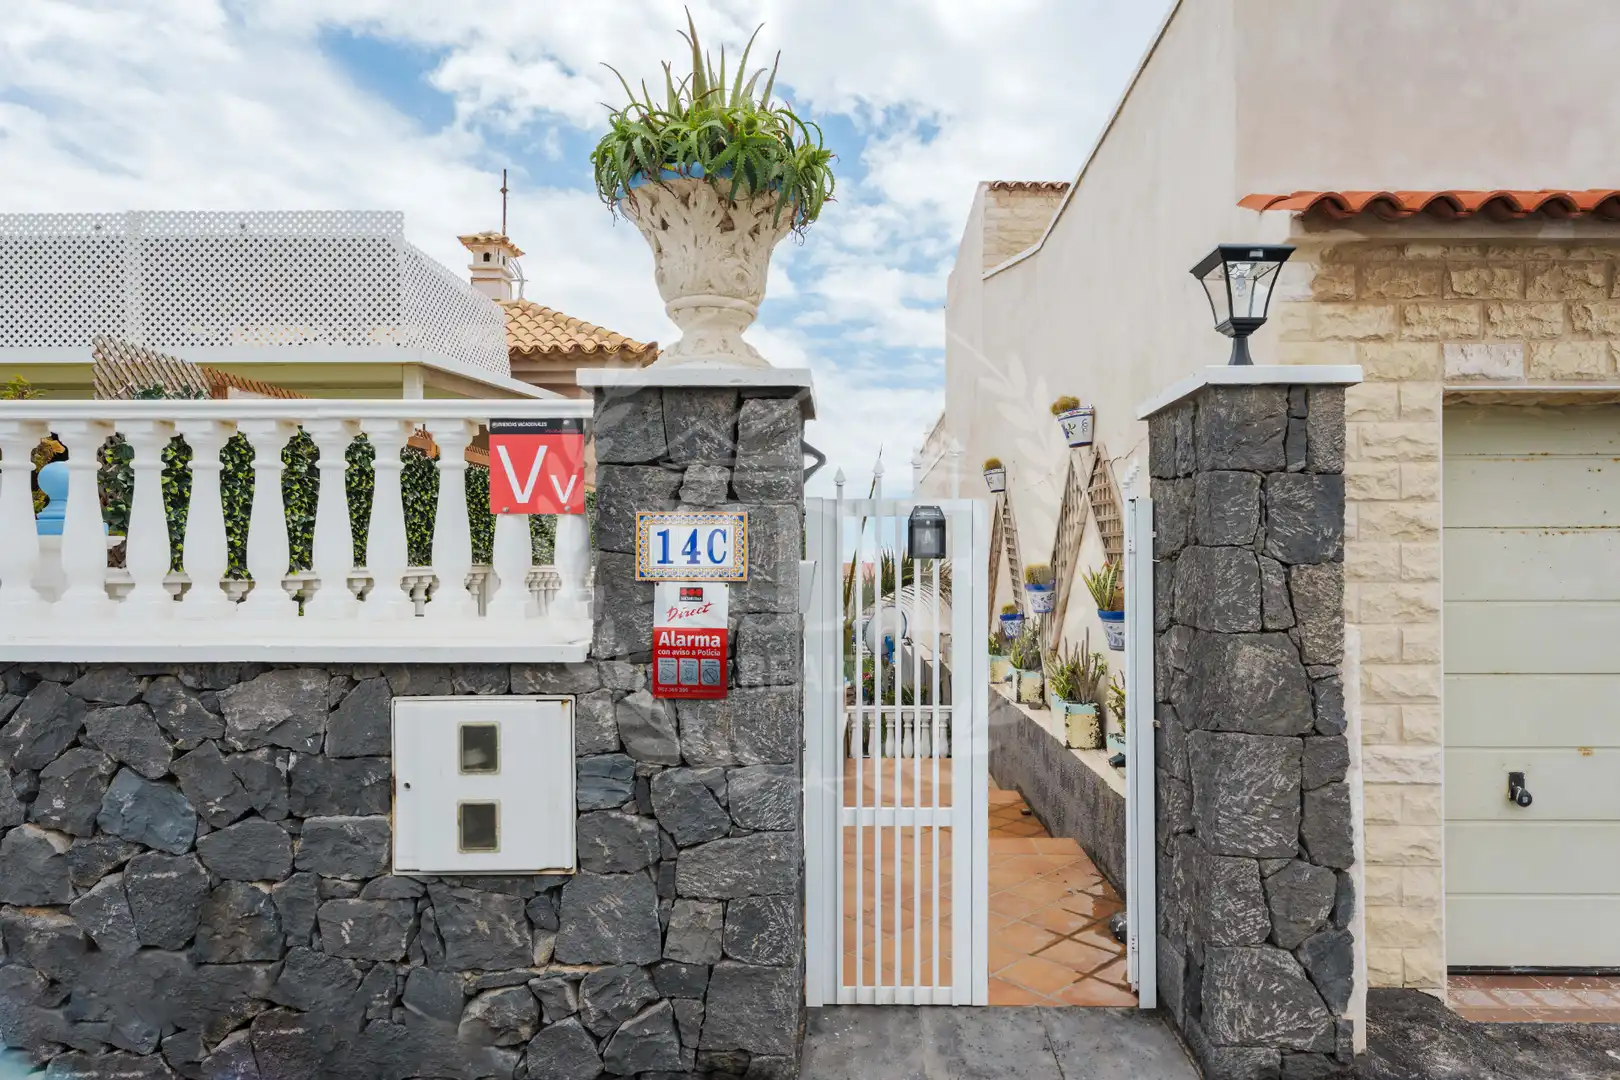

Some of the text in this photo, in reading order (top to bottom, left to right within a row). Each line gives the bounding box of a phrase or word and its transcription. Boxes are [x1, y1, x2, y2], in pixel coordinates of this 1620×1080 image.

[656, 528, 727, 564] 14C
[666, 601, 712, 622] Direct
[658, 631, 720, 647] Alarma
[671, 647, 690, 655] aviso
